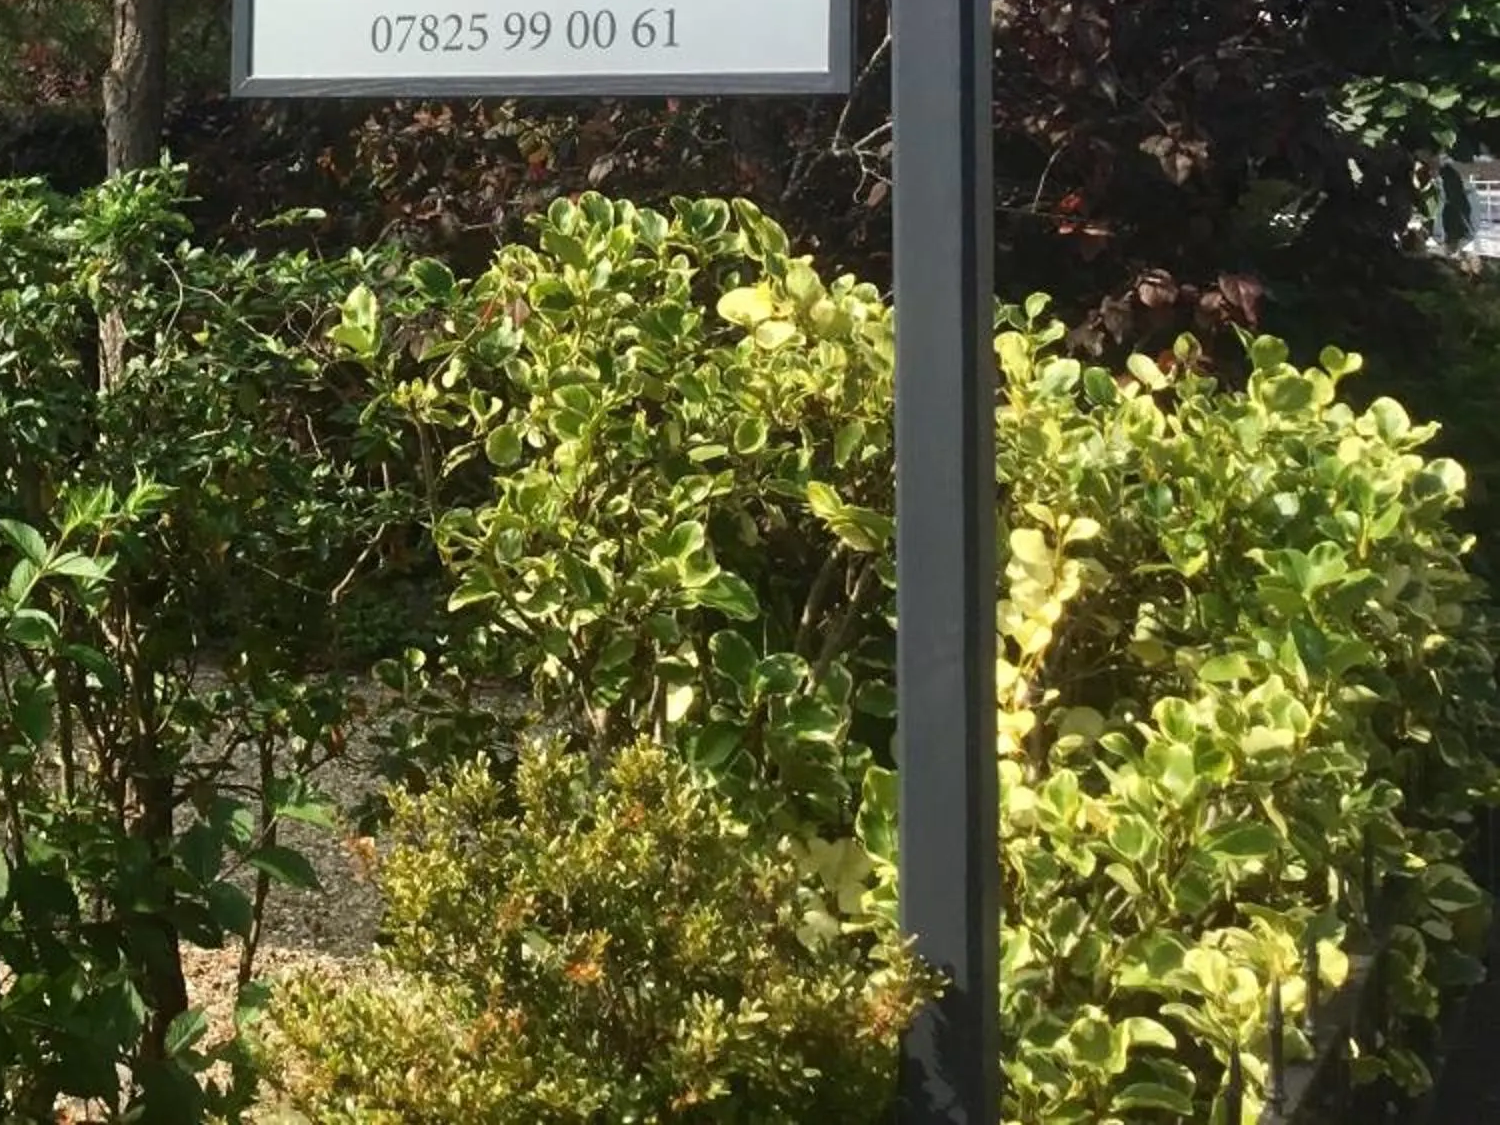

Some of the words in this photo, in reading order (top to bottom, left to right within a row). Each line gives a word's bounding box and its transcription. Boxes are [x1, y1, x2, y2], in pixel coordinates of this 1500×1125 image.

[370, 13, 489, 53] 07825
[503, 11, 552, 51] 99
[566, 9, 618, 50] 00
[631, 8, 680, 49] 61
